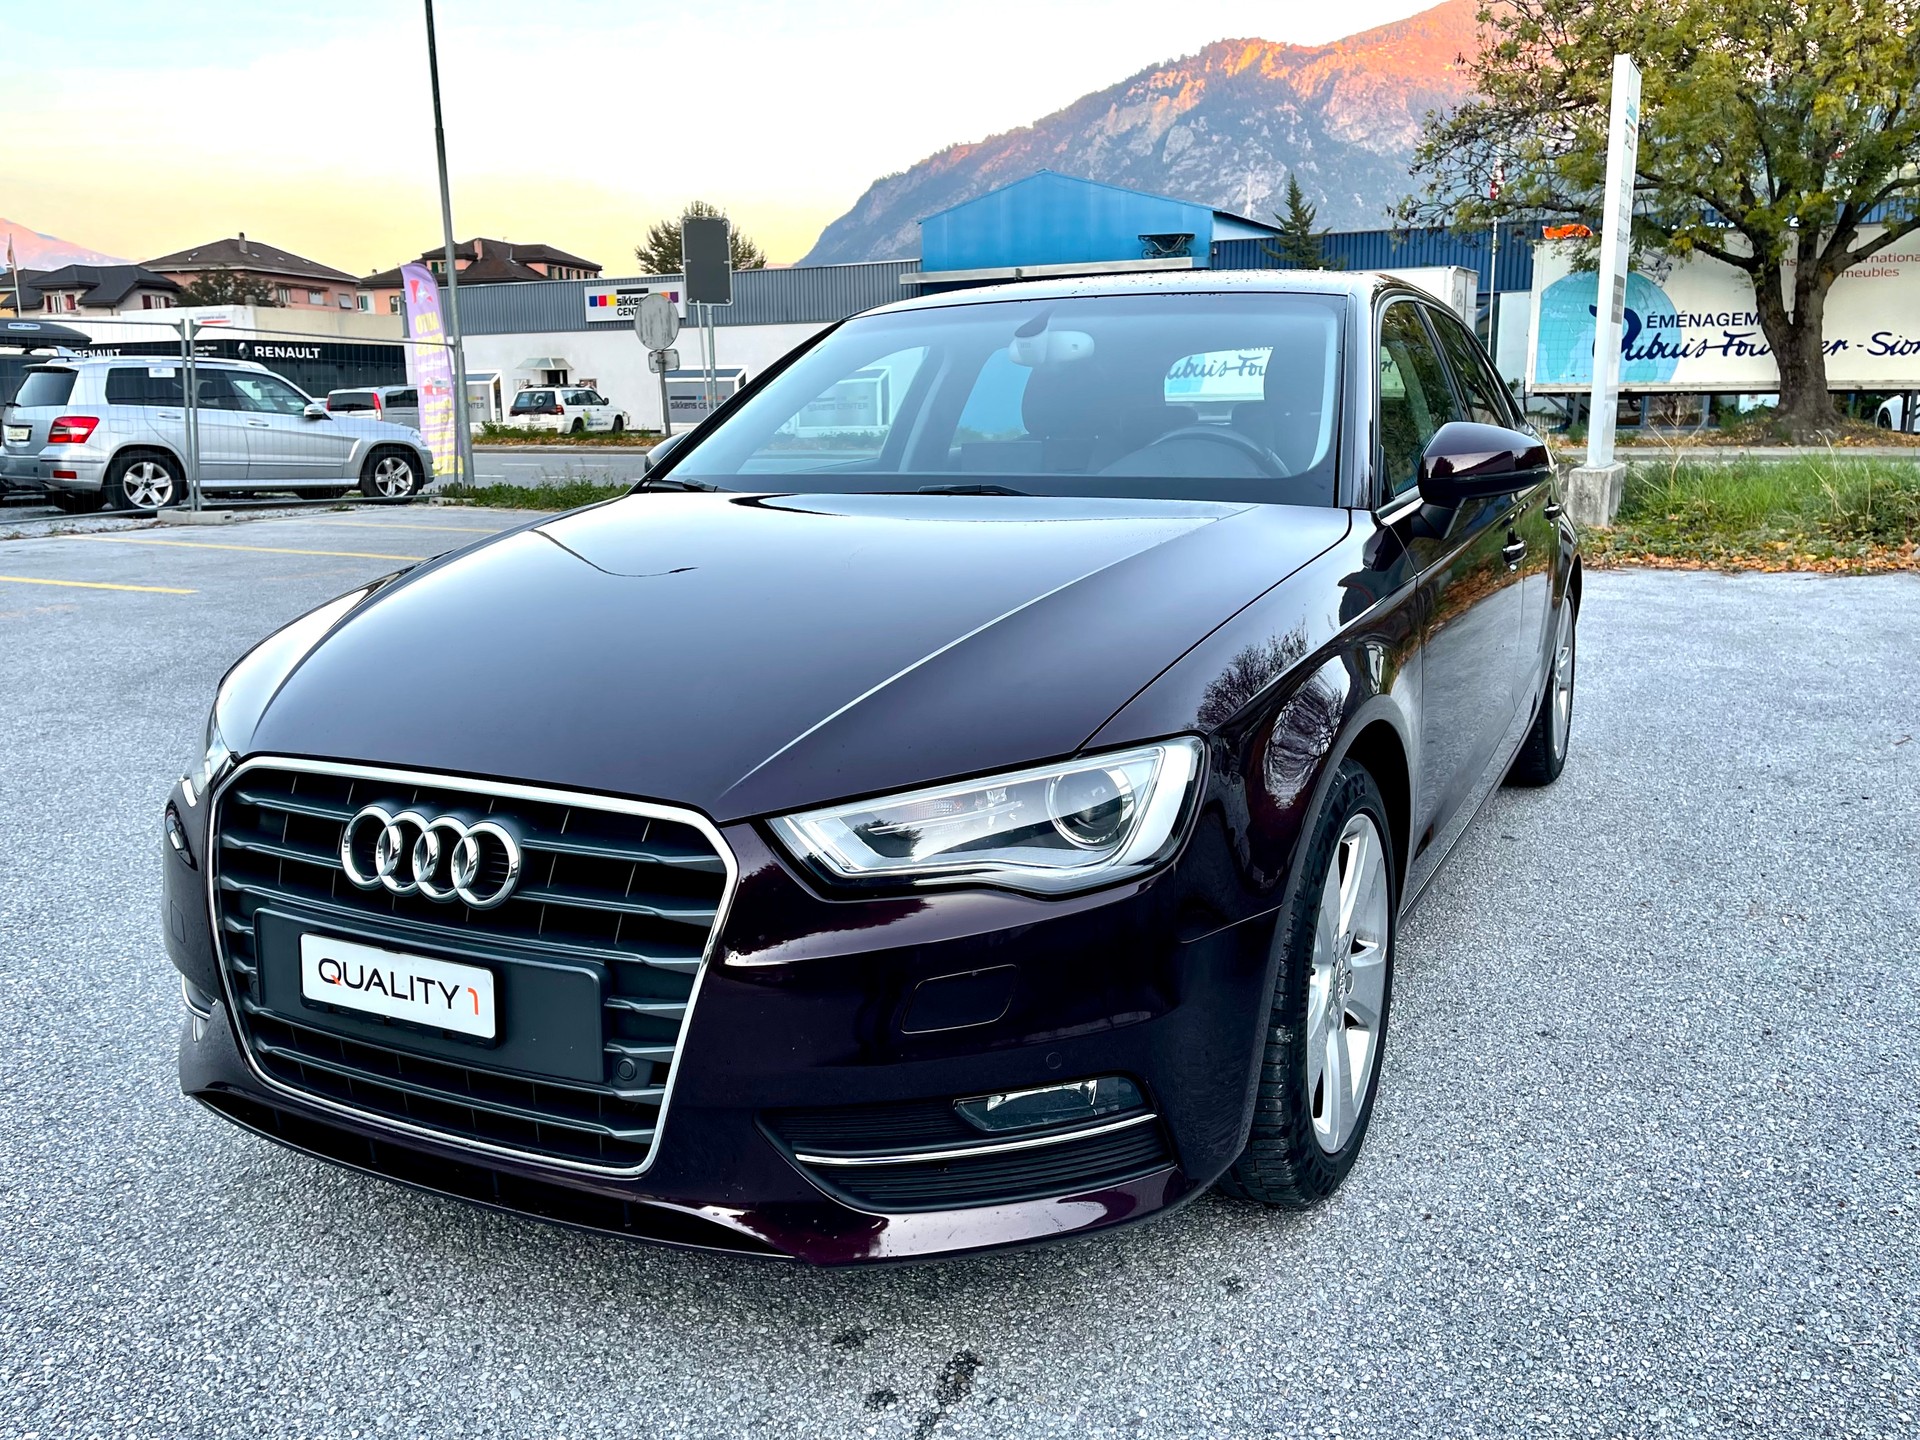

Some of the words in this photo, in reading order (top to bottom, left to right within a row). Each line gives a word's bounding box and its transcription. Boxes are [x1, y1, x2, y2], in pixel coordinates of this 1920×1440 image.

[1841, 267, 1900, 278] meubles
[616, 307, 638, 317] CEN
[253, 345, 321, 359] RENAULT
[318, 957, 460, 1010] QUALITY
